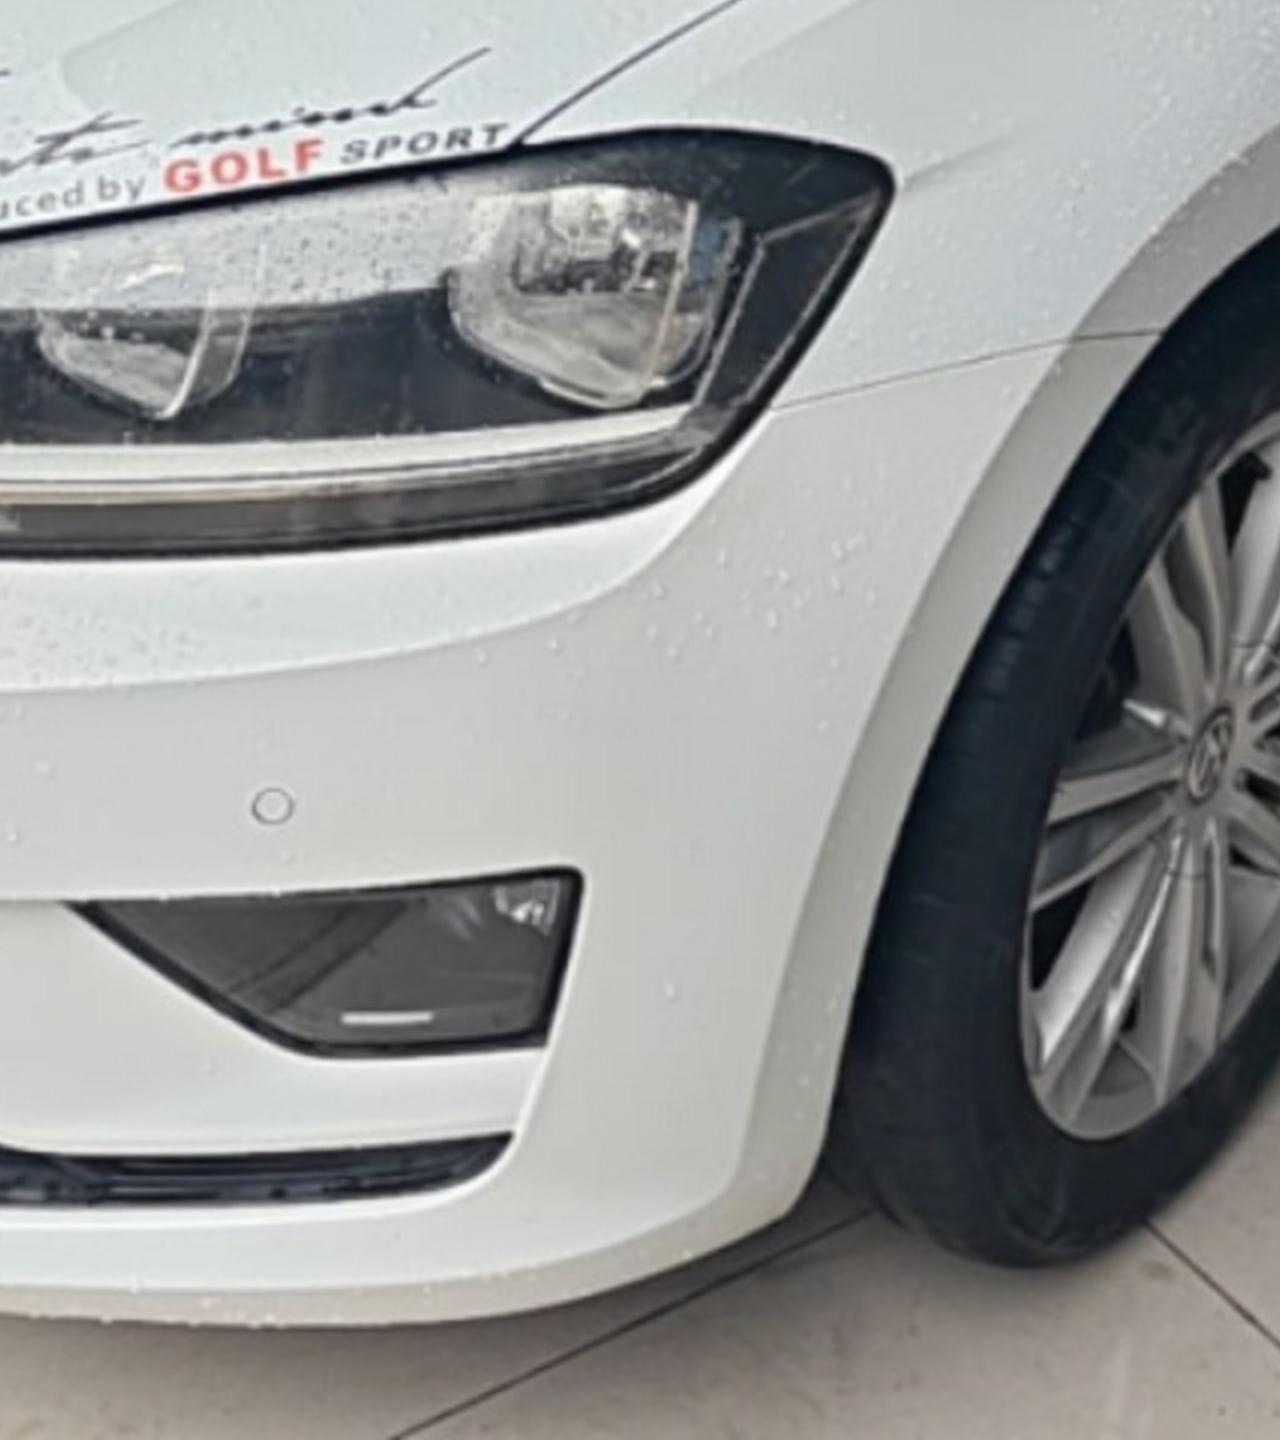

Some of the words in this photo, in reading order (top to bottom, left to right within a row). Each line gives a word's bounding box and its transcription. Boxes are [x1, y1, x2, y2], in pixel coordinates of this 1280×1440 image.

[97, 172, 146, 203] by
[163, 138, 324, 192] GOLF
[339, 121, 510, 165] SPORT
